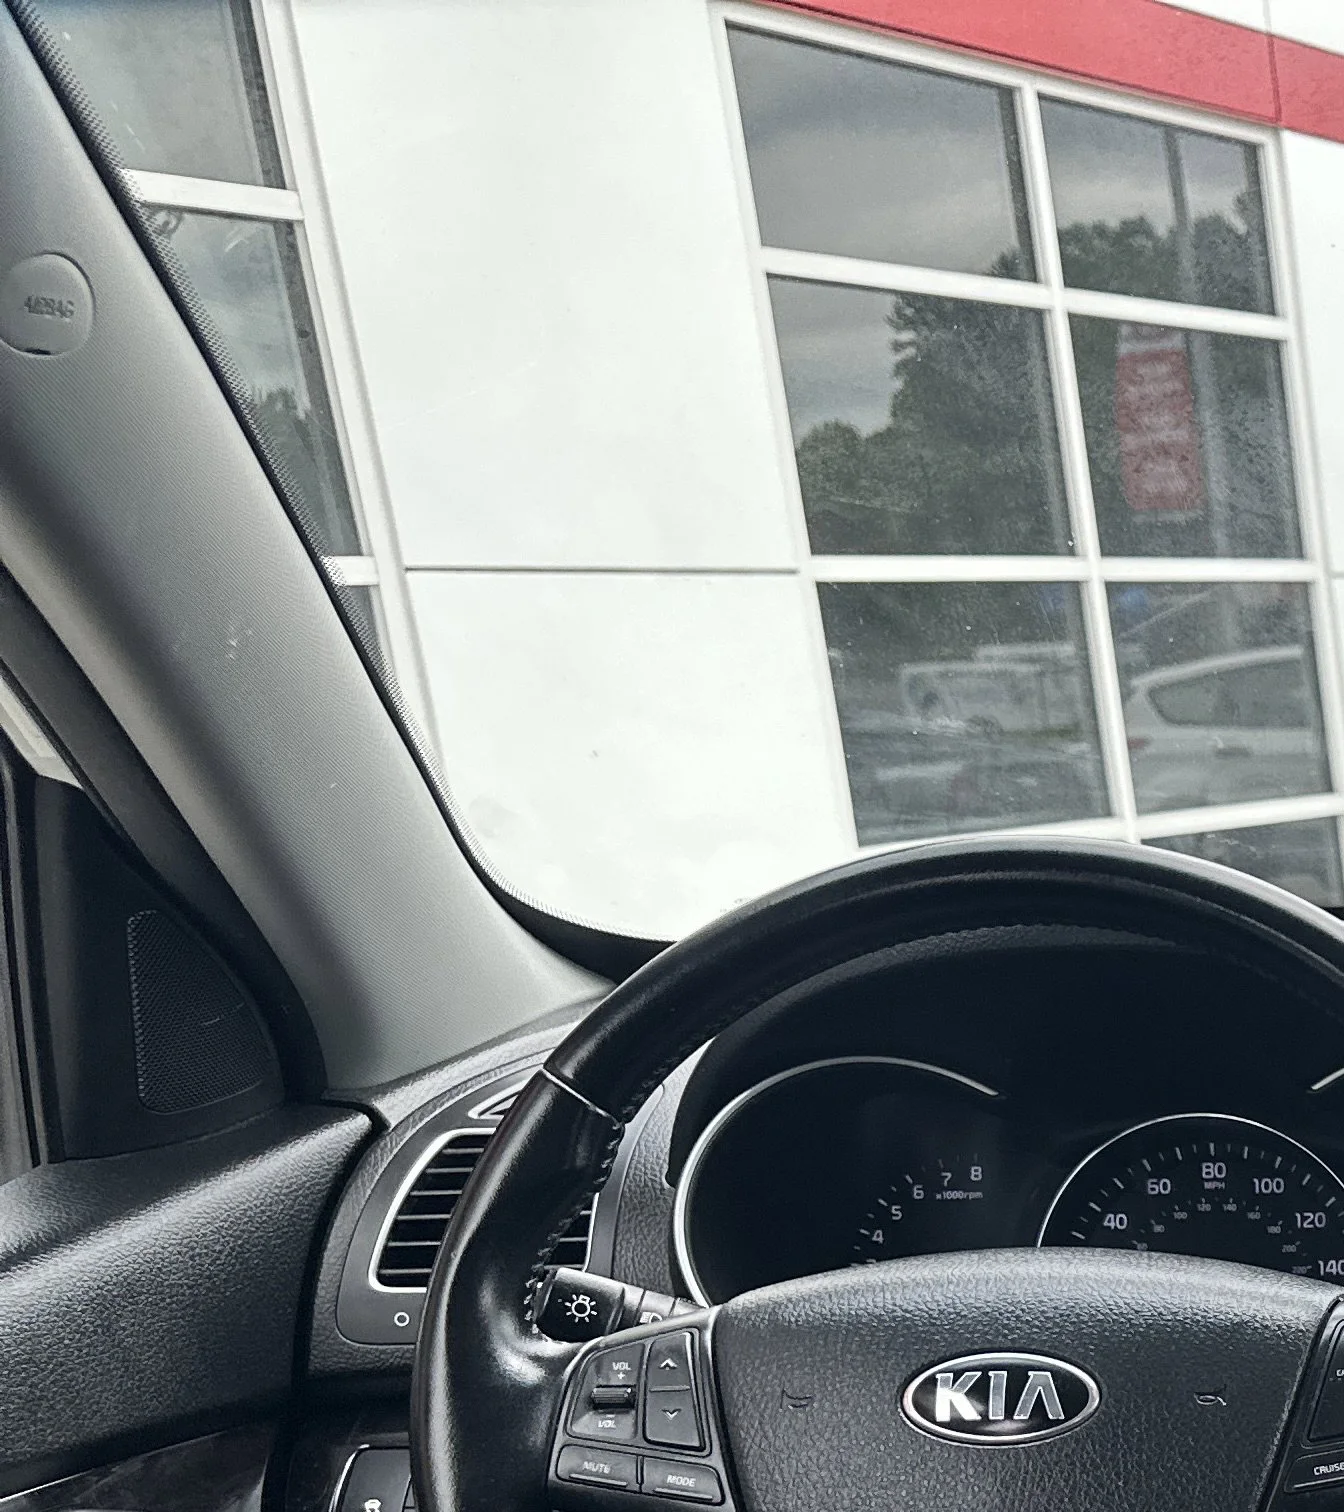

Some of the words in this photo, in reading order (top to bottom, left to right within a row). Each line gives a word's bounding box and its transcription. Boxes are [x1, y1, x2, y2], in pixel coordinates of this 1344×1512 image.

[970, 1166, 983, 1181] 8
[1201, 1162, 1227, 1179] 80
[941, 1172, 952, 1187] 7
[1147, 1178, 1172, 1195] 60
[1204, 1181, 1226, 1190] MPH
[1253, 1178, 1285, 1194] 100
[912, 1185, 925, 1200] 6
[891, 1205, 903, 1221] 5
[1295, 1212, 1327, 1229] 120
[1103, 1213, 1128, 1230] 40
[871, 1229, 885, 1245] 4
[612, 1361, 632, 1371] VOL
[935, 1370, 1065, 1423] KIA
[582, 1461, 612, 1474] MUTE
[666, 1474, 697, 1488] MODE
